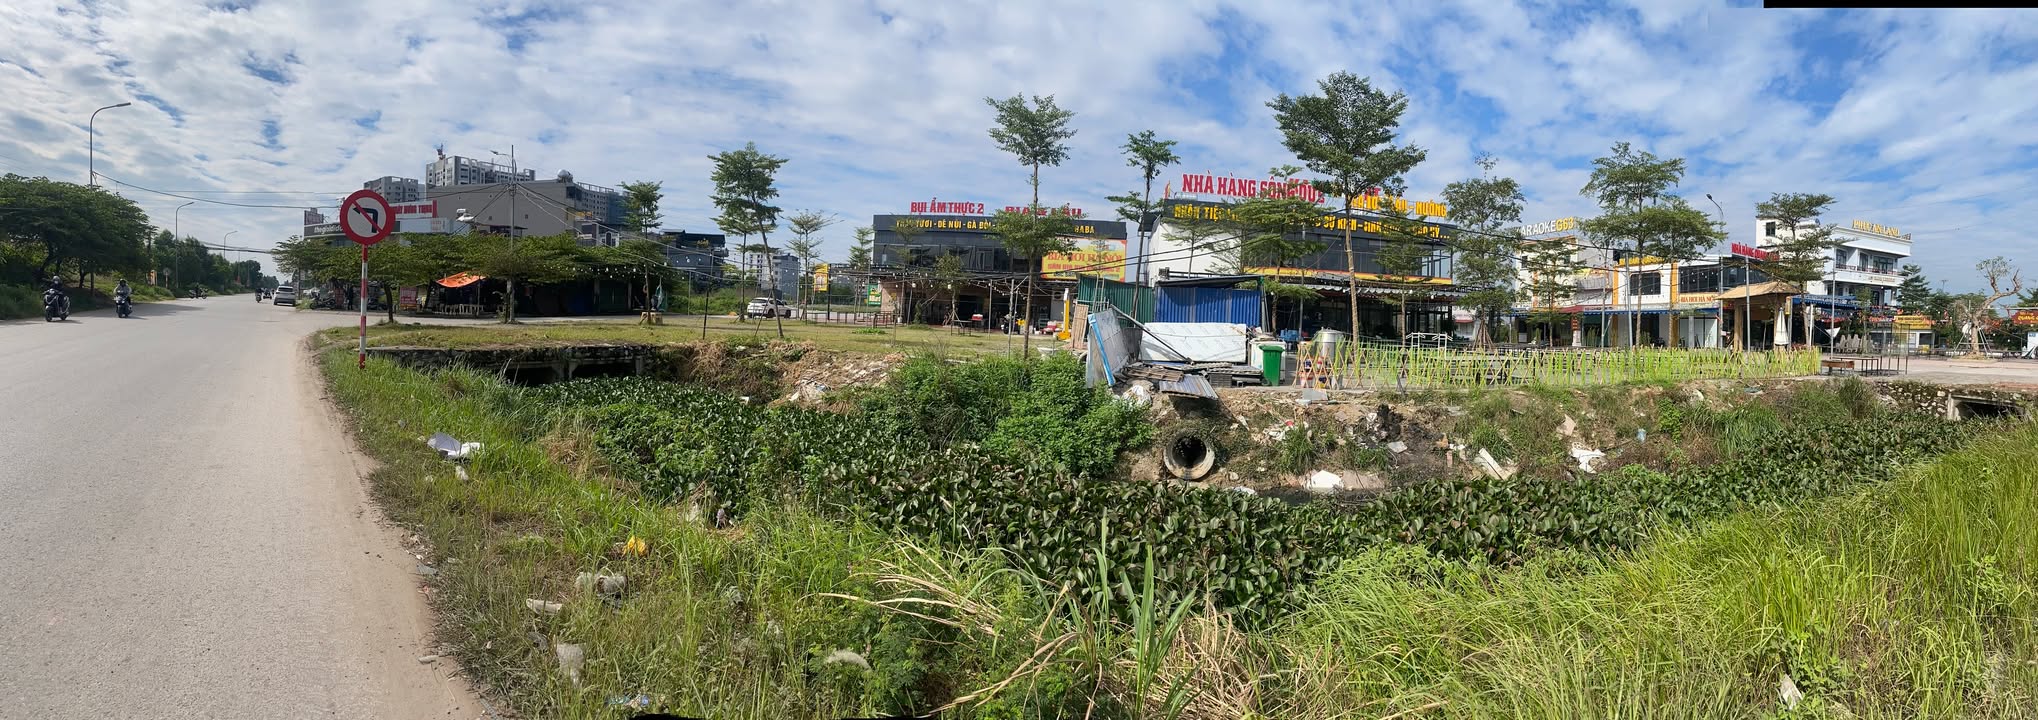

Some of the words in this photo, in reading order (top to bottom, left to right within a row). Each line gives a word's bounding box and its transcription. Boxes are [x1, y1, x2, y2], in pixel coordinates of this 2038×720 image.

[1182, 170, 1214, 193] NHÀ
[1217, 172, 1256, 197] HÀNG
[976, 203, 984, 214] 2
[1337, 216, 1356, 231] KIN
[1518, 220, 1555, 236] ARAOKE
